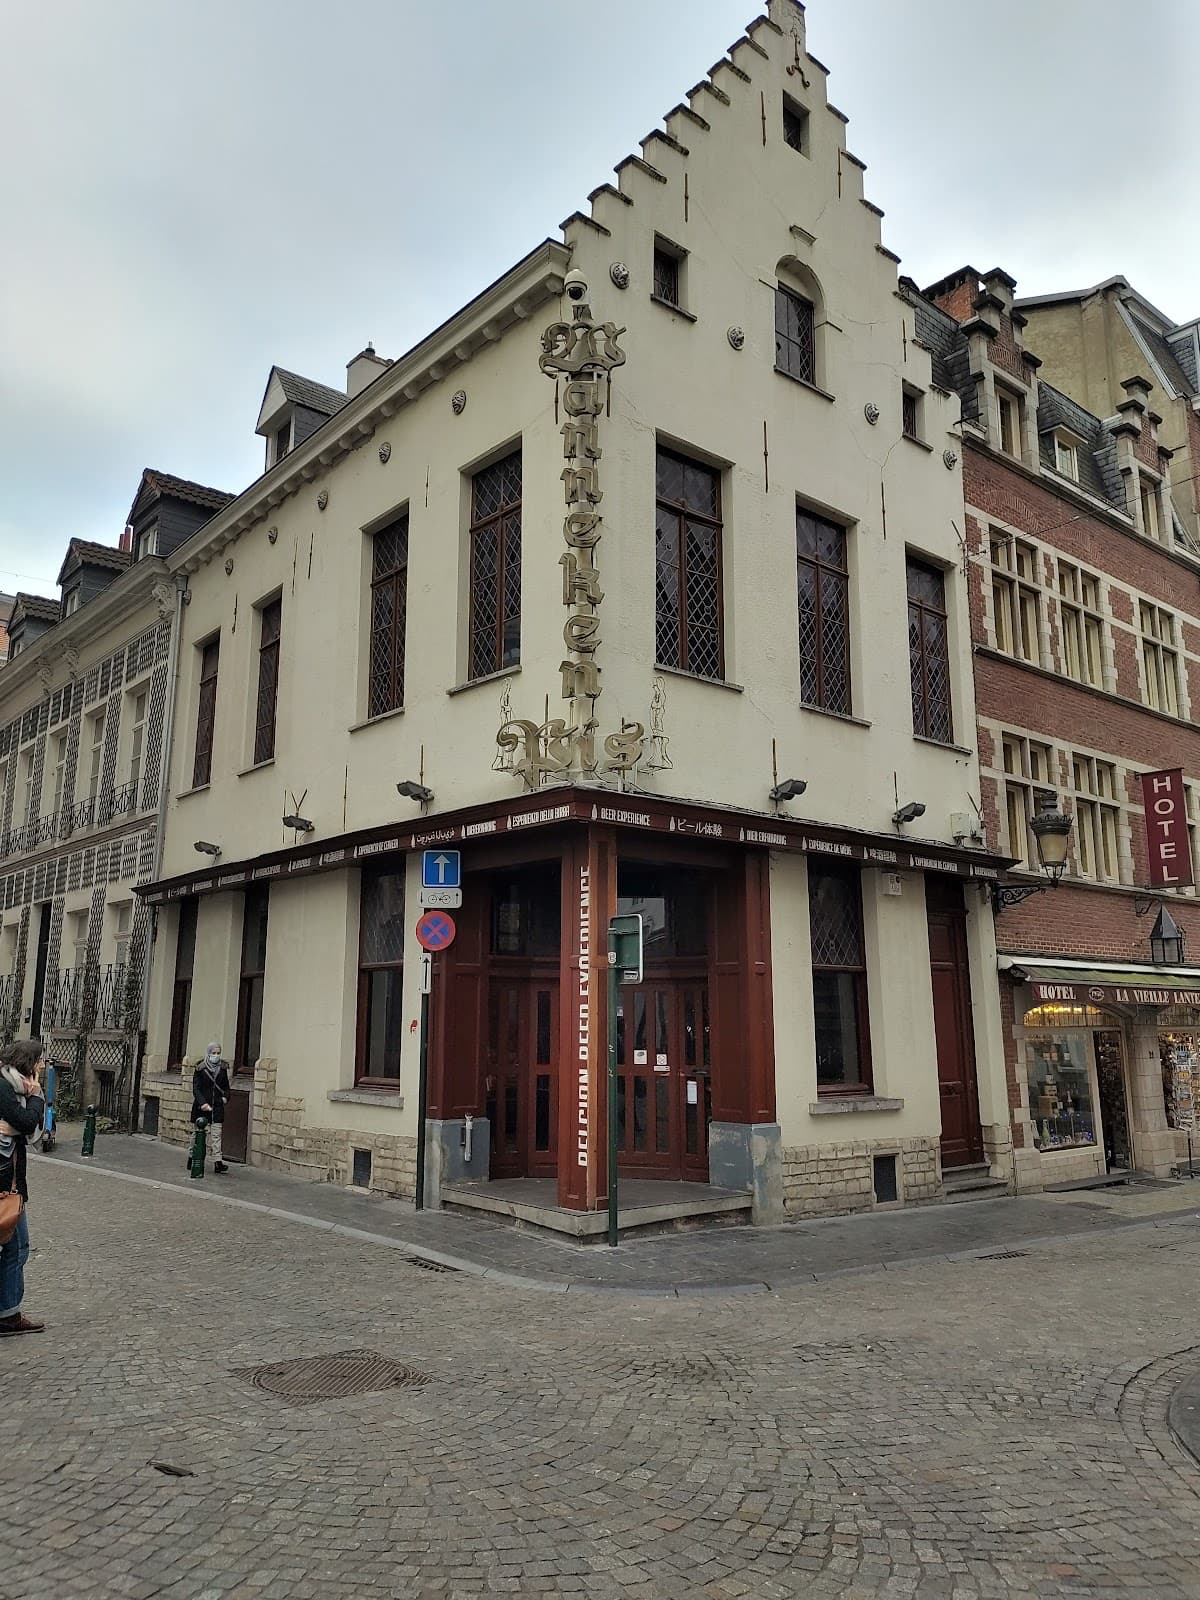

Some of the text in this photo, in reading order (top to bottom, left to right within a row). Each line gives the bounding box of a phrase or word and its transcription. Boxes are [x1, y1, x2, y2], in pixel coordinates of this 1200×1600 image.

[538, 321, 627, 699] Manneken
[496, 718, 644, 790] Pis
[601, 808, 651, 826] BEER EXPERIENCE
[677, 818, 722, 837] ビール体験
[1152, 775, 1179, 882] HOTEL
[1039, 984, 1077, 1000] HOTEL
[1115, 988, 1130, 1002] LA
[1133, 989, 1170, 1004] VIEILLE
